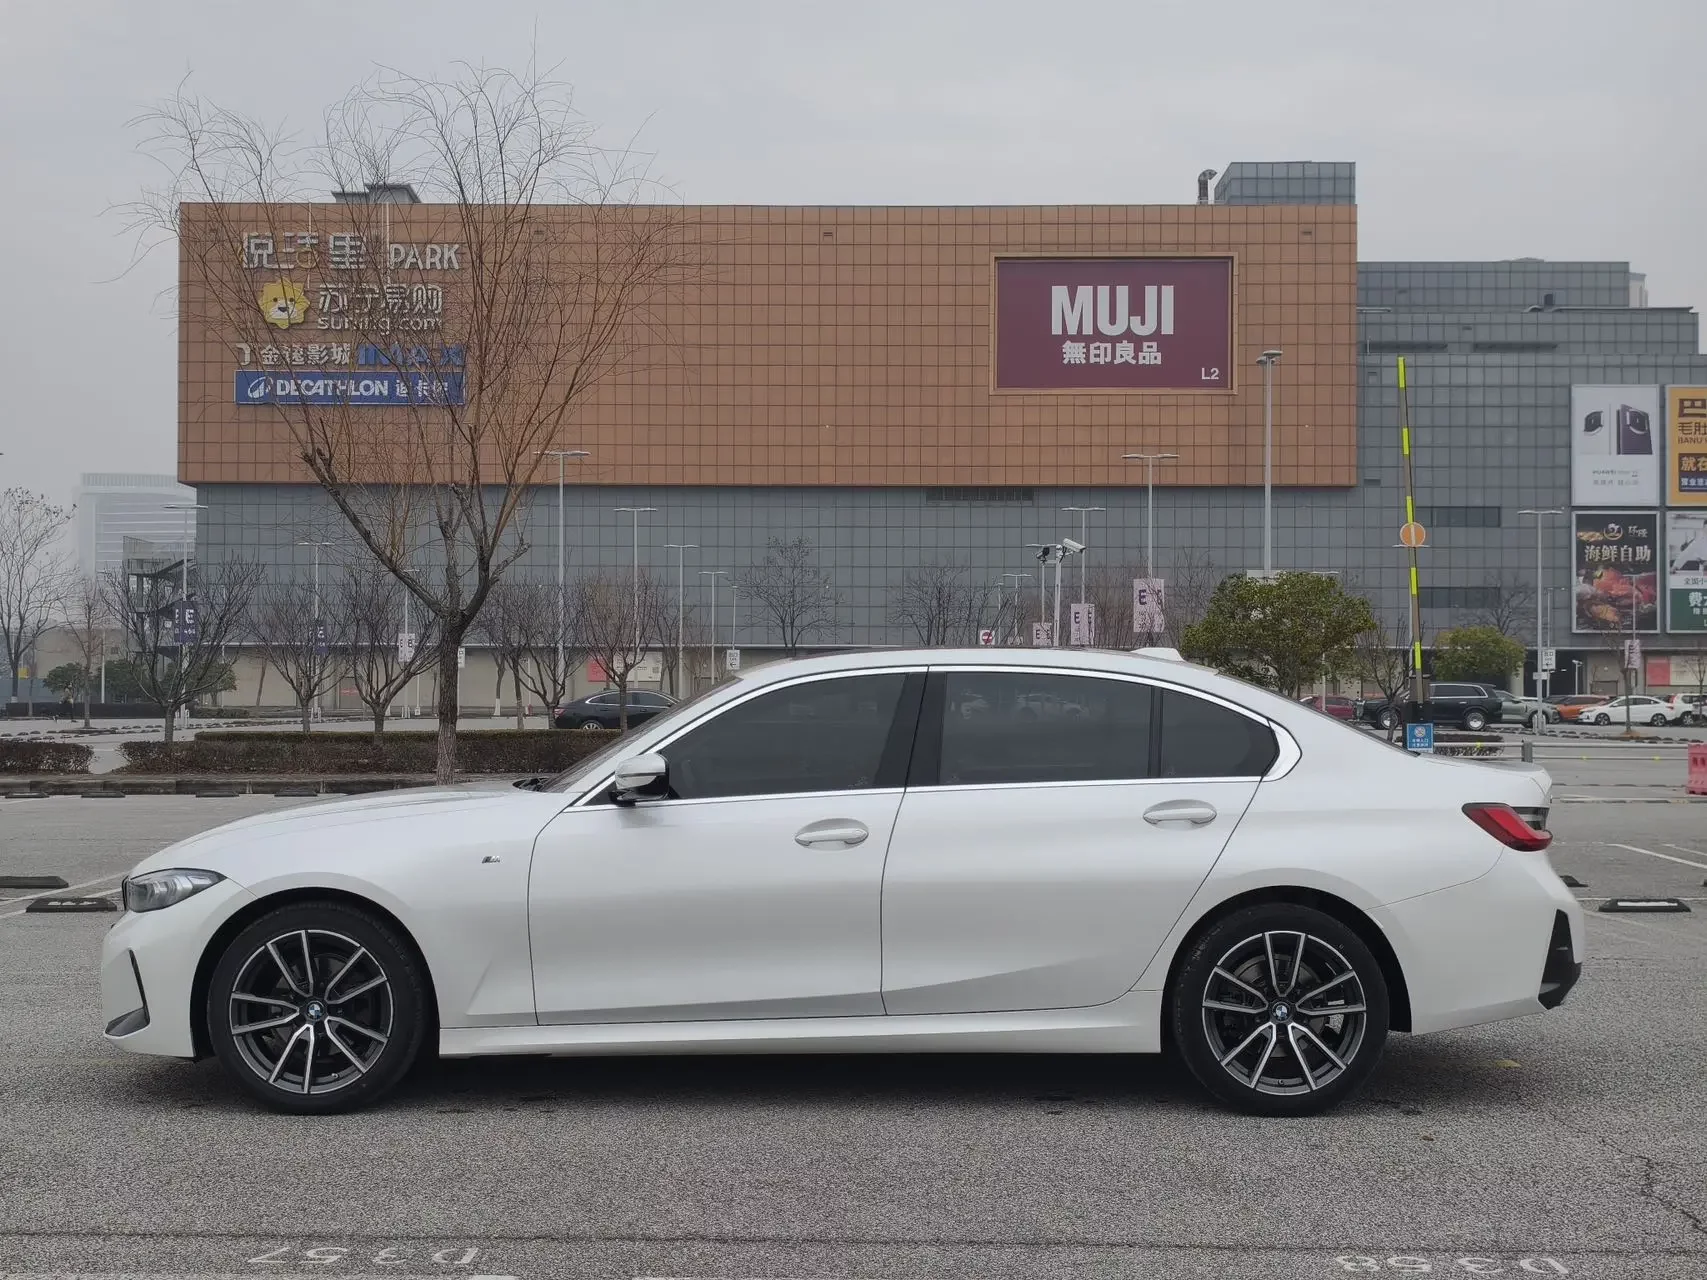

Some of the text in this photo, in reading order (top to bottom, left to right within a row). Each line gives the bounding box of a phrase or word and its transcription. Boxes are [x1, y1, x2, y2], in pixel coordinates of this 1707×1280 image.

[389, 243, 459, 270] PARK
[1051, 285, 1175, 336] MUJI
[1062, 340, 1162, 365] 無印良品
[1201, 367, 1220, 380] L2
[276, 379, 389, 397] DECATHLON
[1584, 544, 1652, 562] 海鲜自助
